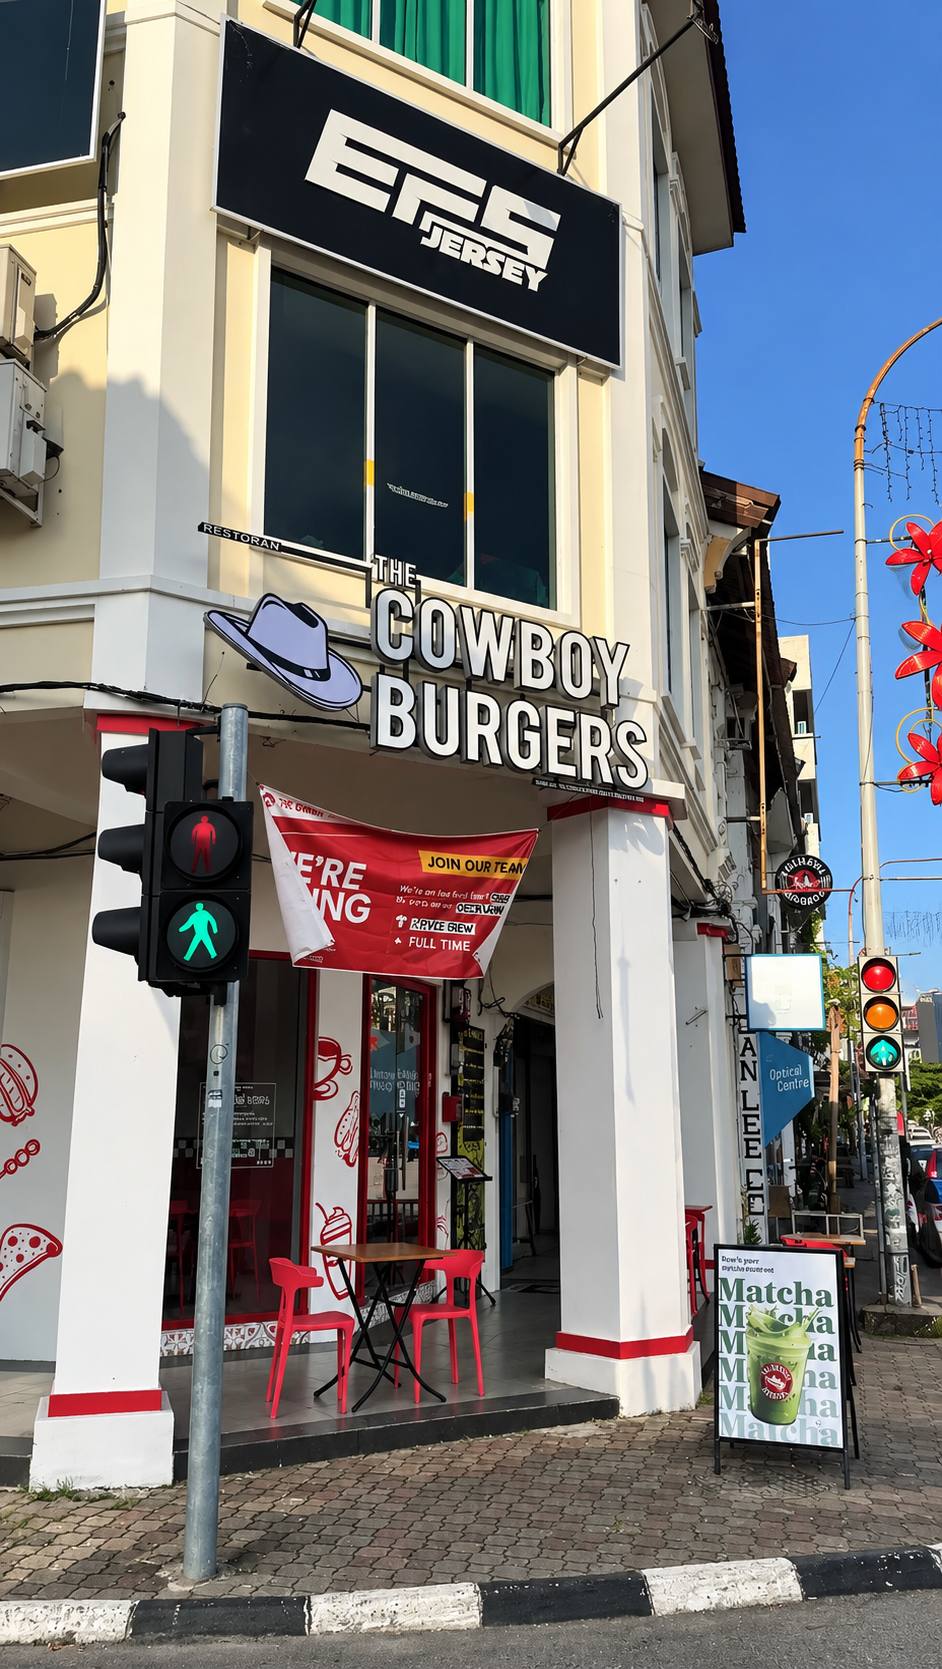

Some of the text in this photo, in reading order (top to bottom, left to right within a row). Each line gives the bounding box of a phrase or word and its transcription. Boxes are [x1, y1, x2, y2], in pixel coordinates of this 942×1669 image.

[420, 225, 548, 292] JERSEY
[203, 524, 280, 551] RESTORAN
[374, 555, 417, 589] THE
[373, 588, 630, 709] COWBOY
[374, 672, 648, 789] BURGERS
[291, 851, 367, 890] E'RE
[428, 856, 460, 871] JOIN
[465, 860, 491, 873] OUR
[409, 936, 470, 951] FULL TIME
[770, 1064, 802, 1081] Optical
[777, 1078, 809, 1092] Centre
[719, 1277, 834, 1307] Matcha
